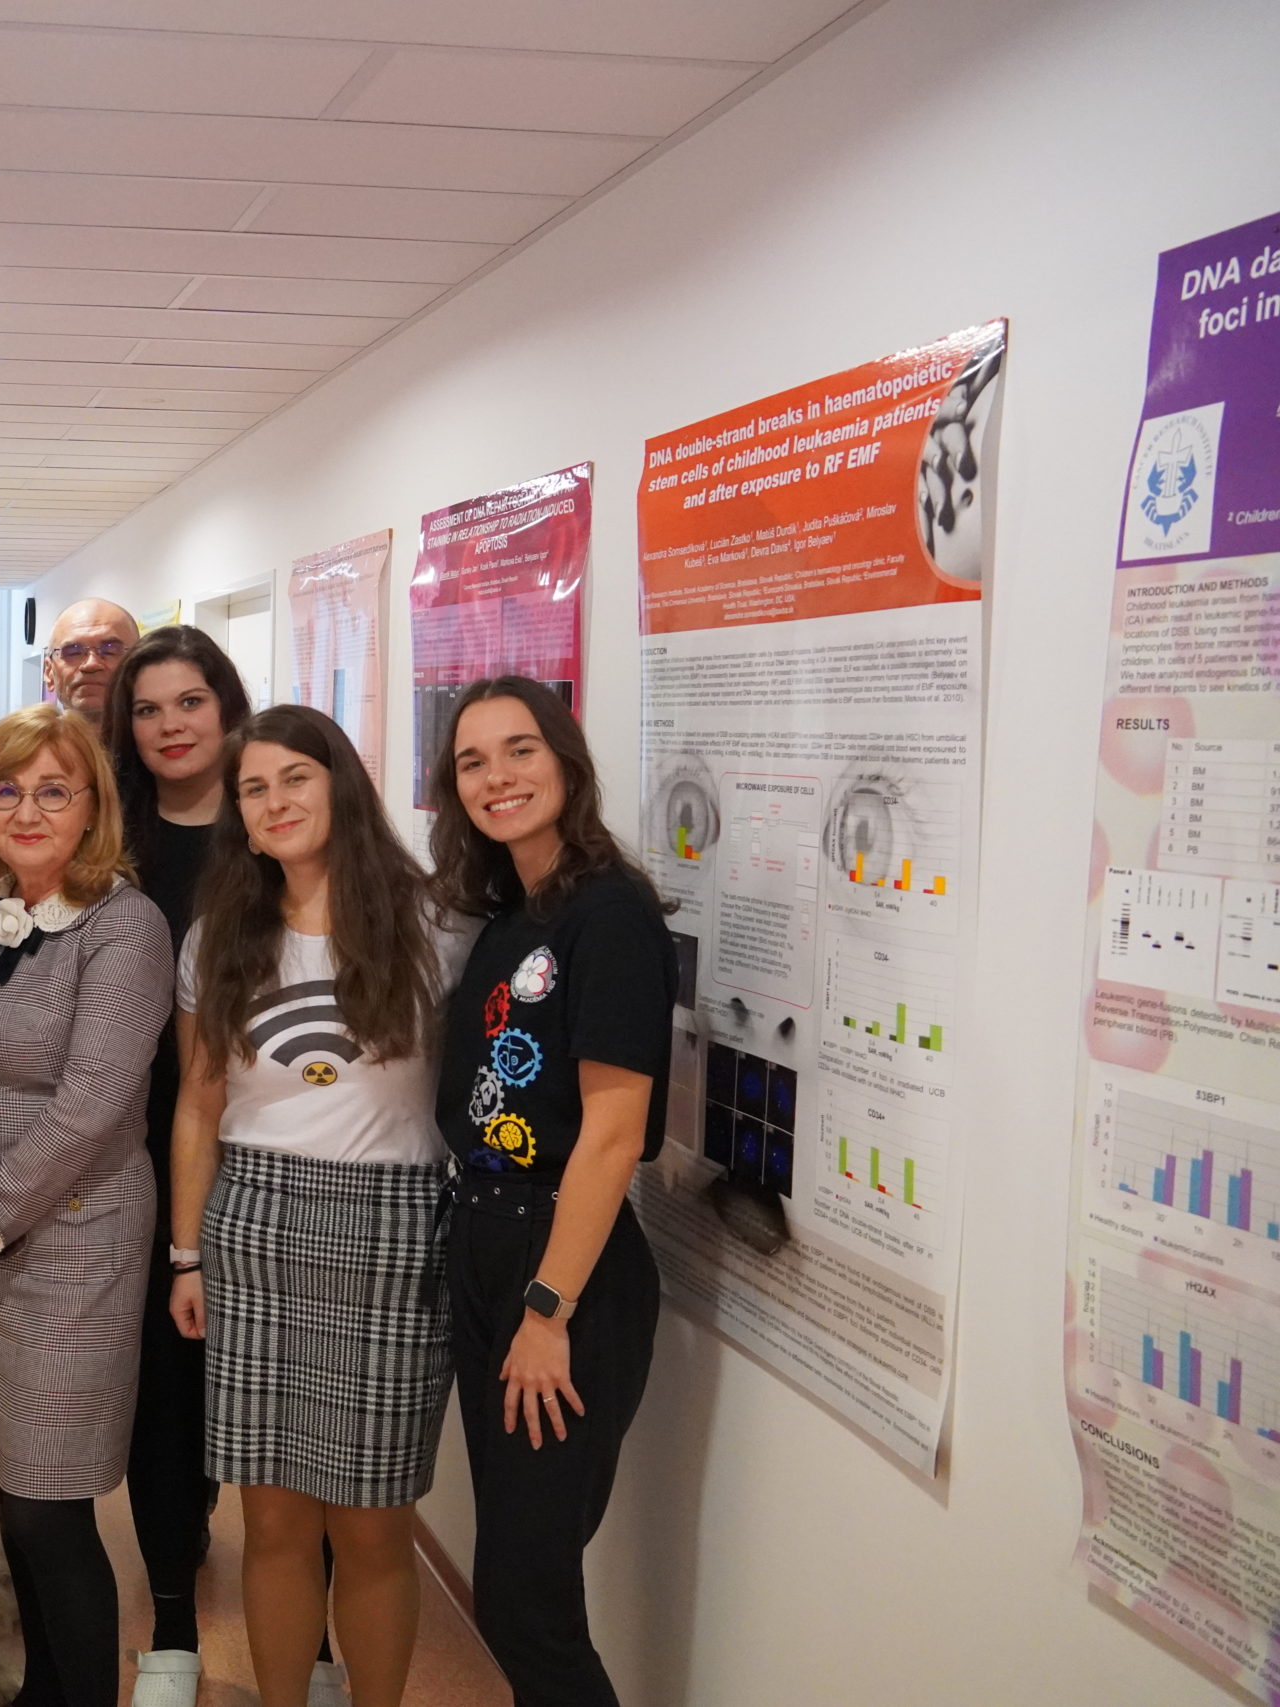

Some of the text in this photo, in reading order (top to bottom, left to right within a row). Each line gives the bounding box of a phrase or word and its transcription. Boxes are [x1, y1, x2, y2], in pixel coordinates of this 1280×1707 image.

[1181, 245, 1280, 301] DNA da
[1199, 291, 1280, 339] foci in
[649, 361, 953, 468] DNA double-strand breaks in haematopoietic
[648, 398, 941, 492] stem cells of childhood leukaemia patients
[683, 441, 881, 509] and after exposure to RF EMF
[866, 503, 897, 519] Miroslav
[430, 512, 464, 532] ASSESSMENT
[475, 535, 508, 555] APOPTOSIS
[1127, 576, 1269, 598] INTRODUCTION AND METHODS
[1126, 601, 1166, 612] Childhood
[1125, 615, 1144, 626] (CA)
[1146, 614, 1169, 624] which
[1124, 628, 1160, 639] locations
[1194, 625, 1217, 637] Using
[1220, 624, 1241, 634] most
[1122, 642, 1173, 654] lymphocytes
[1174, 640, 1192, 650] from
[1194, 639, 1215, 649] bone
[1167, 655, 1186, 665] cells
[1204, 653, 1238, 664] patients
[1120, 670, 1134, 680] We
[1157, 668, 1194, 680] analyzed
[1195, 668, 1248, 679] endogenous
[1119, 684, 1152, 694] different
[1172, 683, 1197, 695] points
[1227, 682, 1259, 692] kinetics
[1261, 681, 1272, 691] of
[1116, 718, 1170, 730] RESULTS
[736, 782, 767, 792] MICROWAVE
[1095, 990, 1243, 1029] Leukemic gene-fusions detected by
[1093, 1016, 1158, 1037] peripheral blood
[1095, 1002, 1266, 1047] Reverse Transcription-Polymerase Chain
[928, 1087, 946, 1098] UCB
[1196, 1090, 1225, 1106] 53BP1
[1094, 1214, 1144, 1238] Healthy donors
[1192, 1248, 1224, 1266] patients
[1081, 1420, 1160, 1469] CONCLUSIONS
